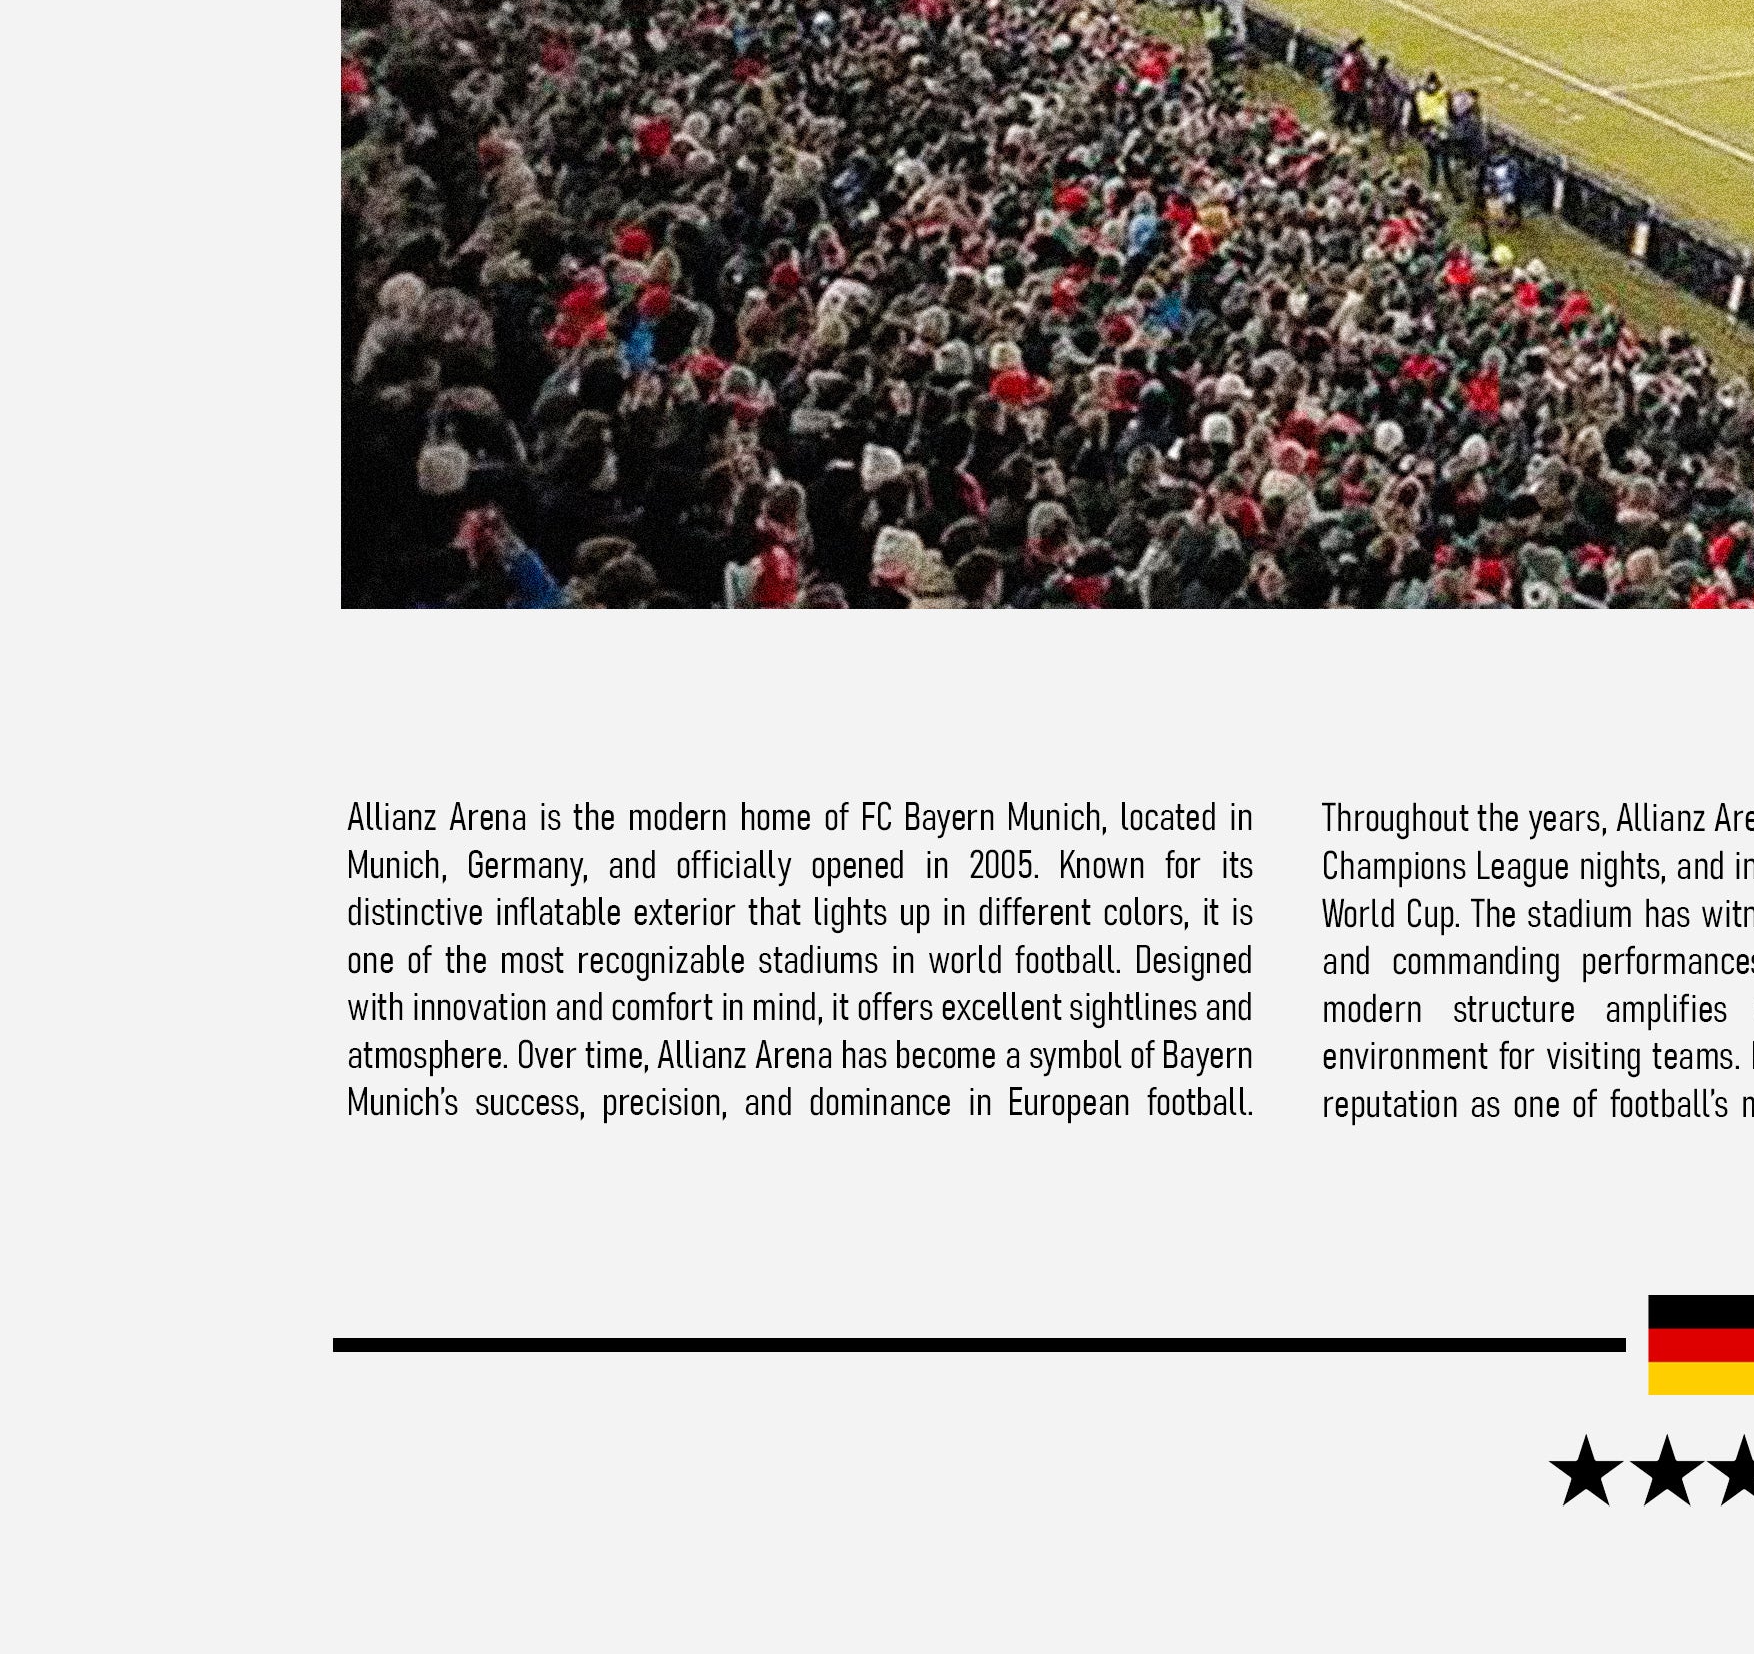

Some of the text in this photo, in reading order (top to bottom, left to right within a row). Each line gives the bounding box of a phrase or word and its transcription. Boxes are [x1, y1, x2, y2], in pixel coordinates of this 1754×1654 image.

[347, 801, 1252, 839] Allianz Arena is the modern home of FC Bayern Munich, located in
[1321, 802, 1469, 840] Throughout
[1477, 802, 1519, 832] the
[1528, 810, 1607, 840] years,
[1616, 802, 1706, 832] Allianz
[348, 849, 1253, 887] Munich, Germany, and officially opened in 2005. Known for its
[1323, 850, 1466, 888] Champions
[1477, 850, 1569, 888] League
[1580, 850, 1666, 888] nights,
[1677, 850, 1724, 880] and
[348, 944, 1252, 982] one of the most recognizable stadiums in world football. Designed
[1323, 945, 1370, 975] and
[1393, 945, 1560, 983] commanding
[347, 991, 1252, 1029] with innovation and comfort in mind, it offers excellent sightlines and
[1323, 993, 1421, 1023] modern
[1453, 995, 1575, 1023] structure
[1606, 993, 1727, 1031] amplifies
[475, 1094, 585, 1121] success,
[603, 1087, 727, 1124] precision,
[745, 1086, 792, 1116] and
[810, 1086, 951, 1116] dominance
[970, 1087, 991, 1116] in
[1009, 1086, 1129, 1124] European
[1147, 1086, 1253, 1116] football.
[1323, 1089, 1457, 1126] reputation
[1471, 1096, 1500, 1118] as
[1514, 1095, 1560, 1118] one
[1573, 1088, 1598, 1118] of
